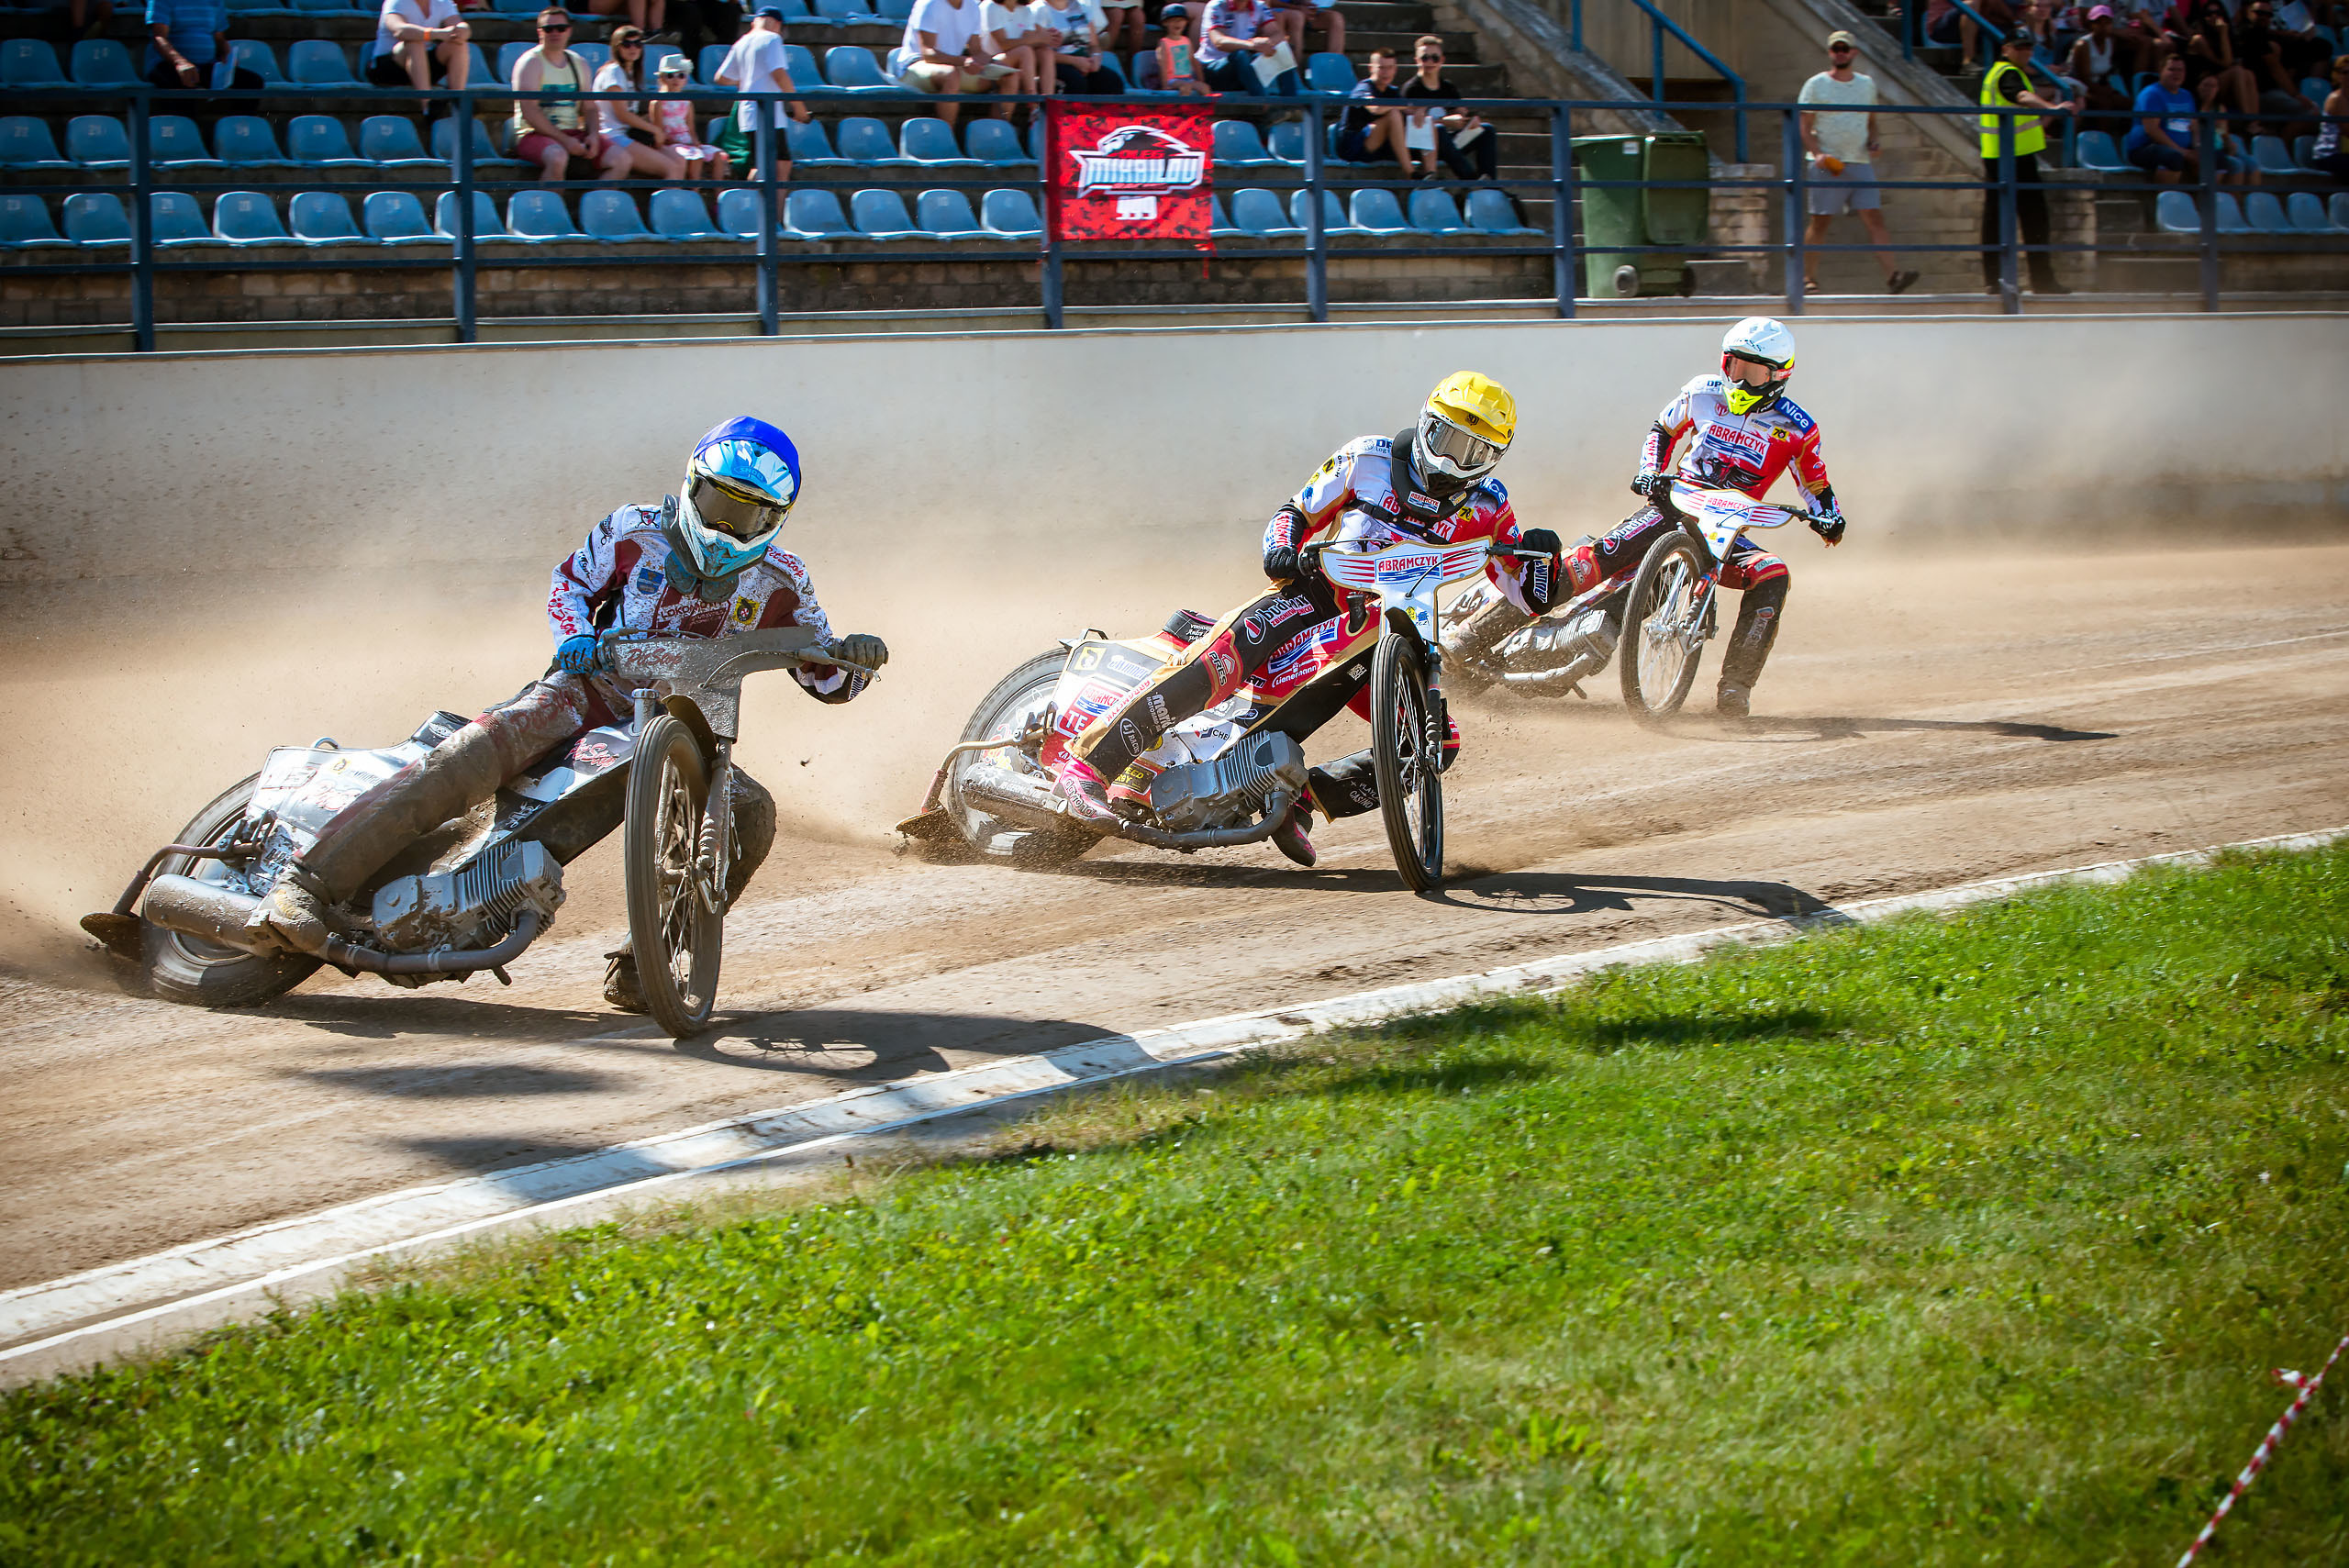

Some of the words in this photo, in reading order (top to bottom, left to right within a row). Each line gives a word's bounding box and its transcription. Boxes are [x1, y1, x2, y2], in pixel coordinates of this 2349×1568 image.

[1781, 401, 1809, 428] Nice
[1709, 424, 1767, 455] ABRAMCZYK
[1410, 493, 1439, 506] ABRAMCZYK
[1708, 497, 1751, 513] ABRAMCZYK
[1378, 556, 1439, 573] ABRAMCZYK
[1207, 651, 1228, 686] PRES
[1275, 664, 1317, 685] Lienermann
[1065, 779, 1097, 817] daytona
[1350, 790, 1374, 809] CASINO
